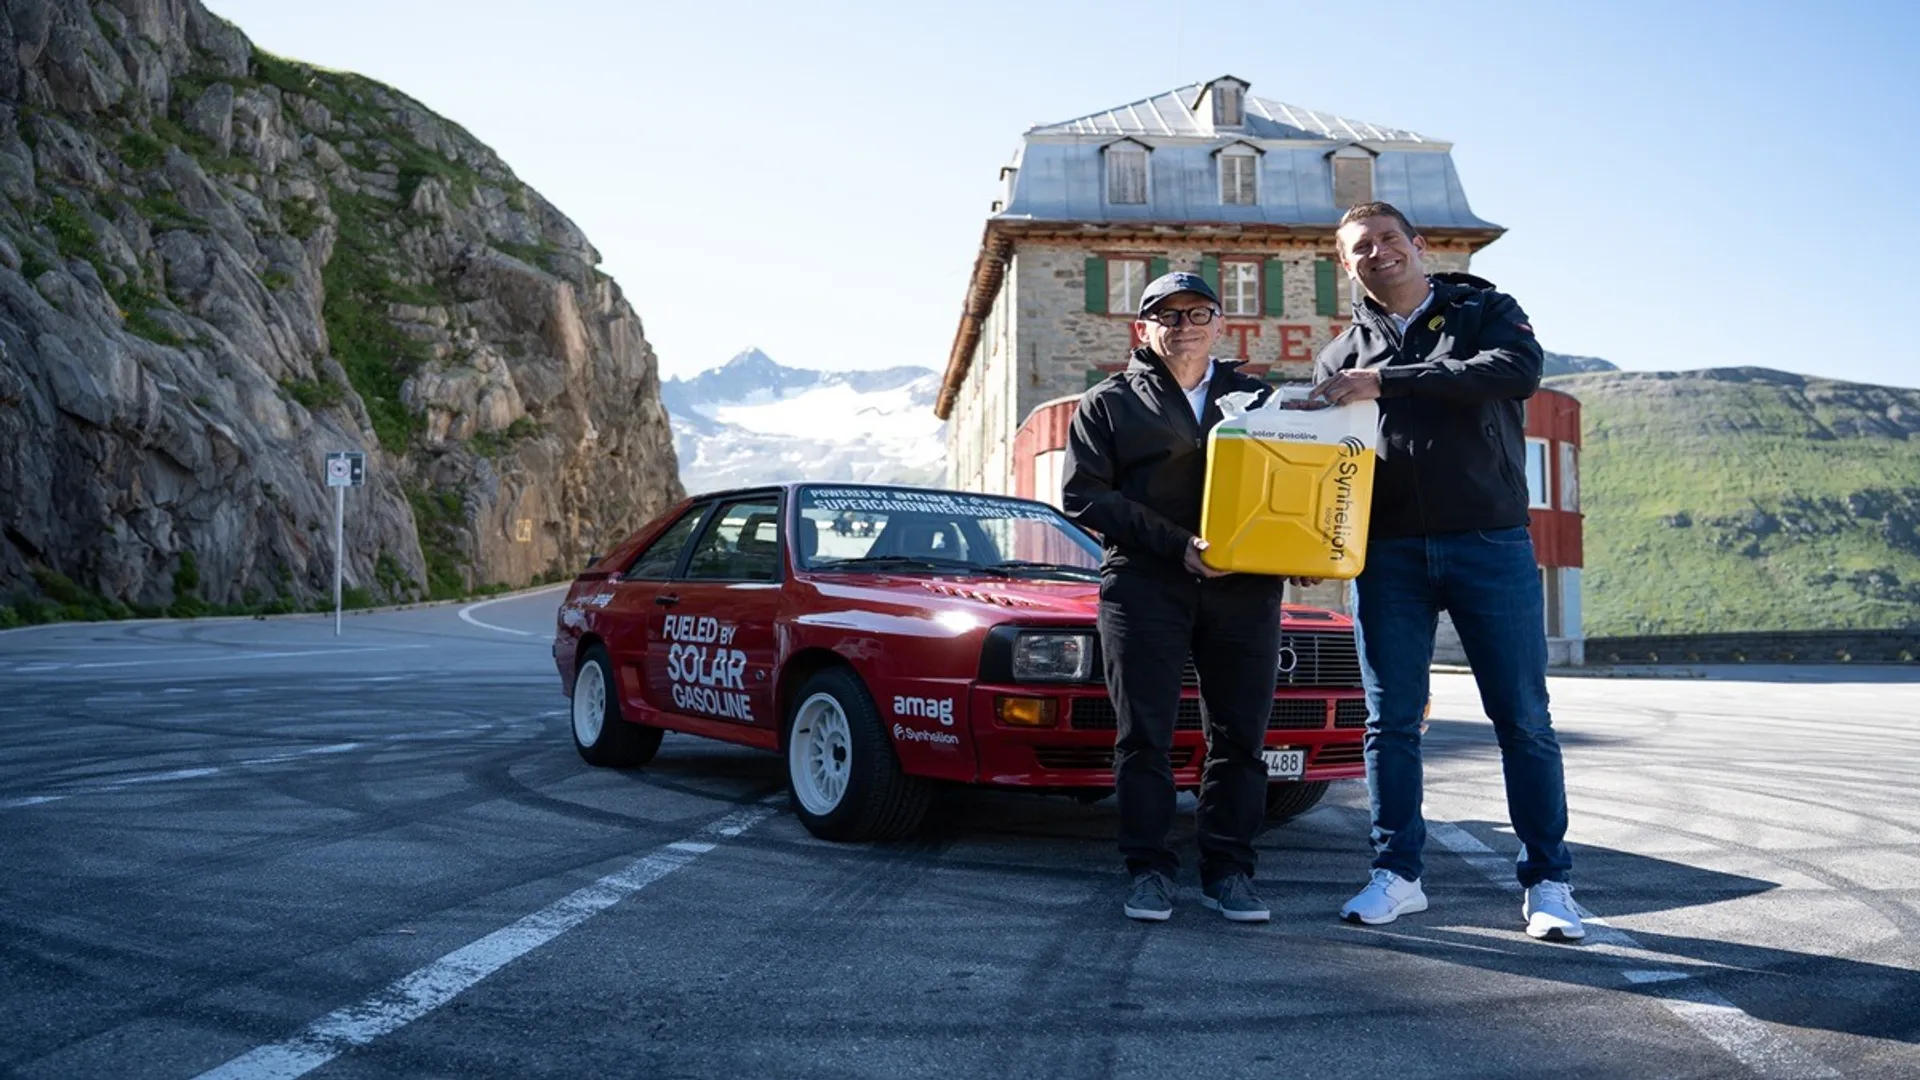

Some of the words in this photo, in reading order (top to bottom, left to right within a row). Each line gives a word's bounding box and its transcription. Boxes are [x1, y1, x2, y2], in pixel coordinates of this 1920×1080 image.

[1251, 429, 1276, 438] solar
[1278, 431, 1318, 441] gasoline
[810, 489, 871, 499] POWERED
[871, 490, 888, 499] BY
[1329, 461, 1358, 562] Synhelion
[663, 614, 718, 643] FUELED
[720, 626, 736, 645] BY
[667, 642, 747, 690] SOLAR
[672, 683, 754, 721] GASOLINE
[893, 695, 954, 726] amag
[905, 726, 960, 745] Synhelion
